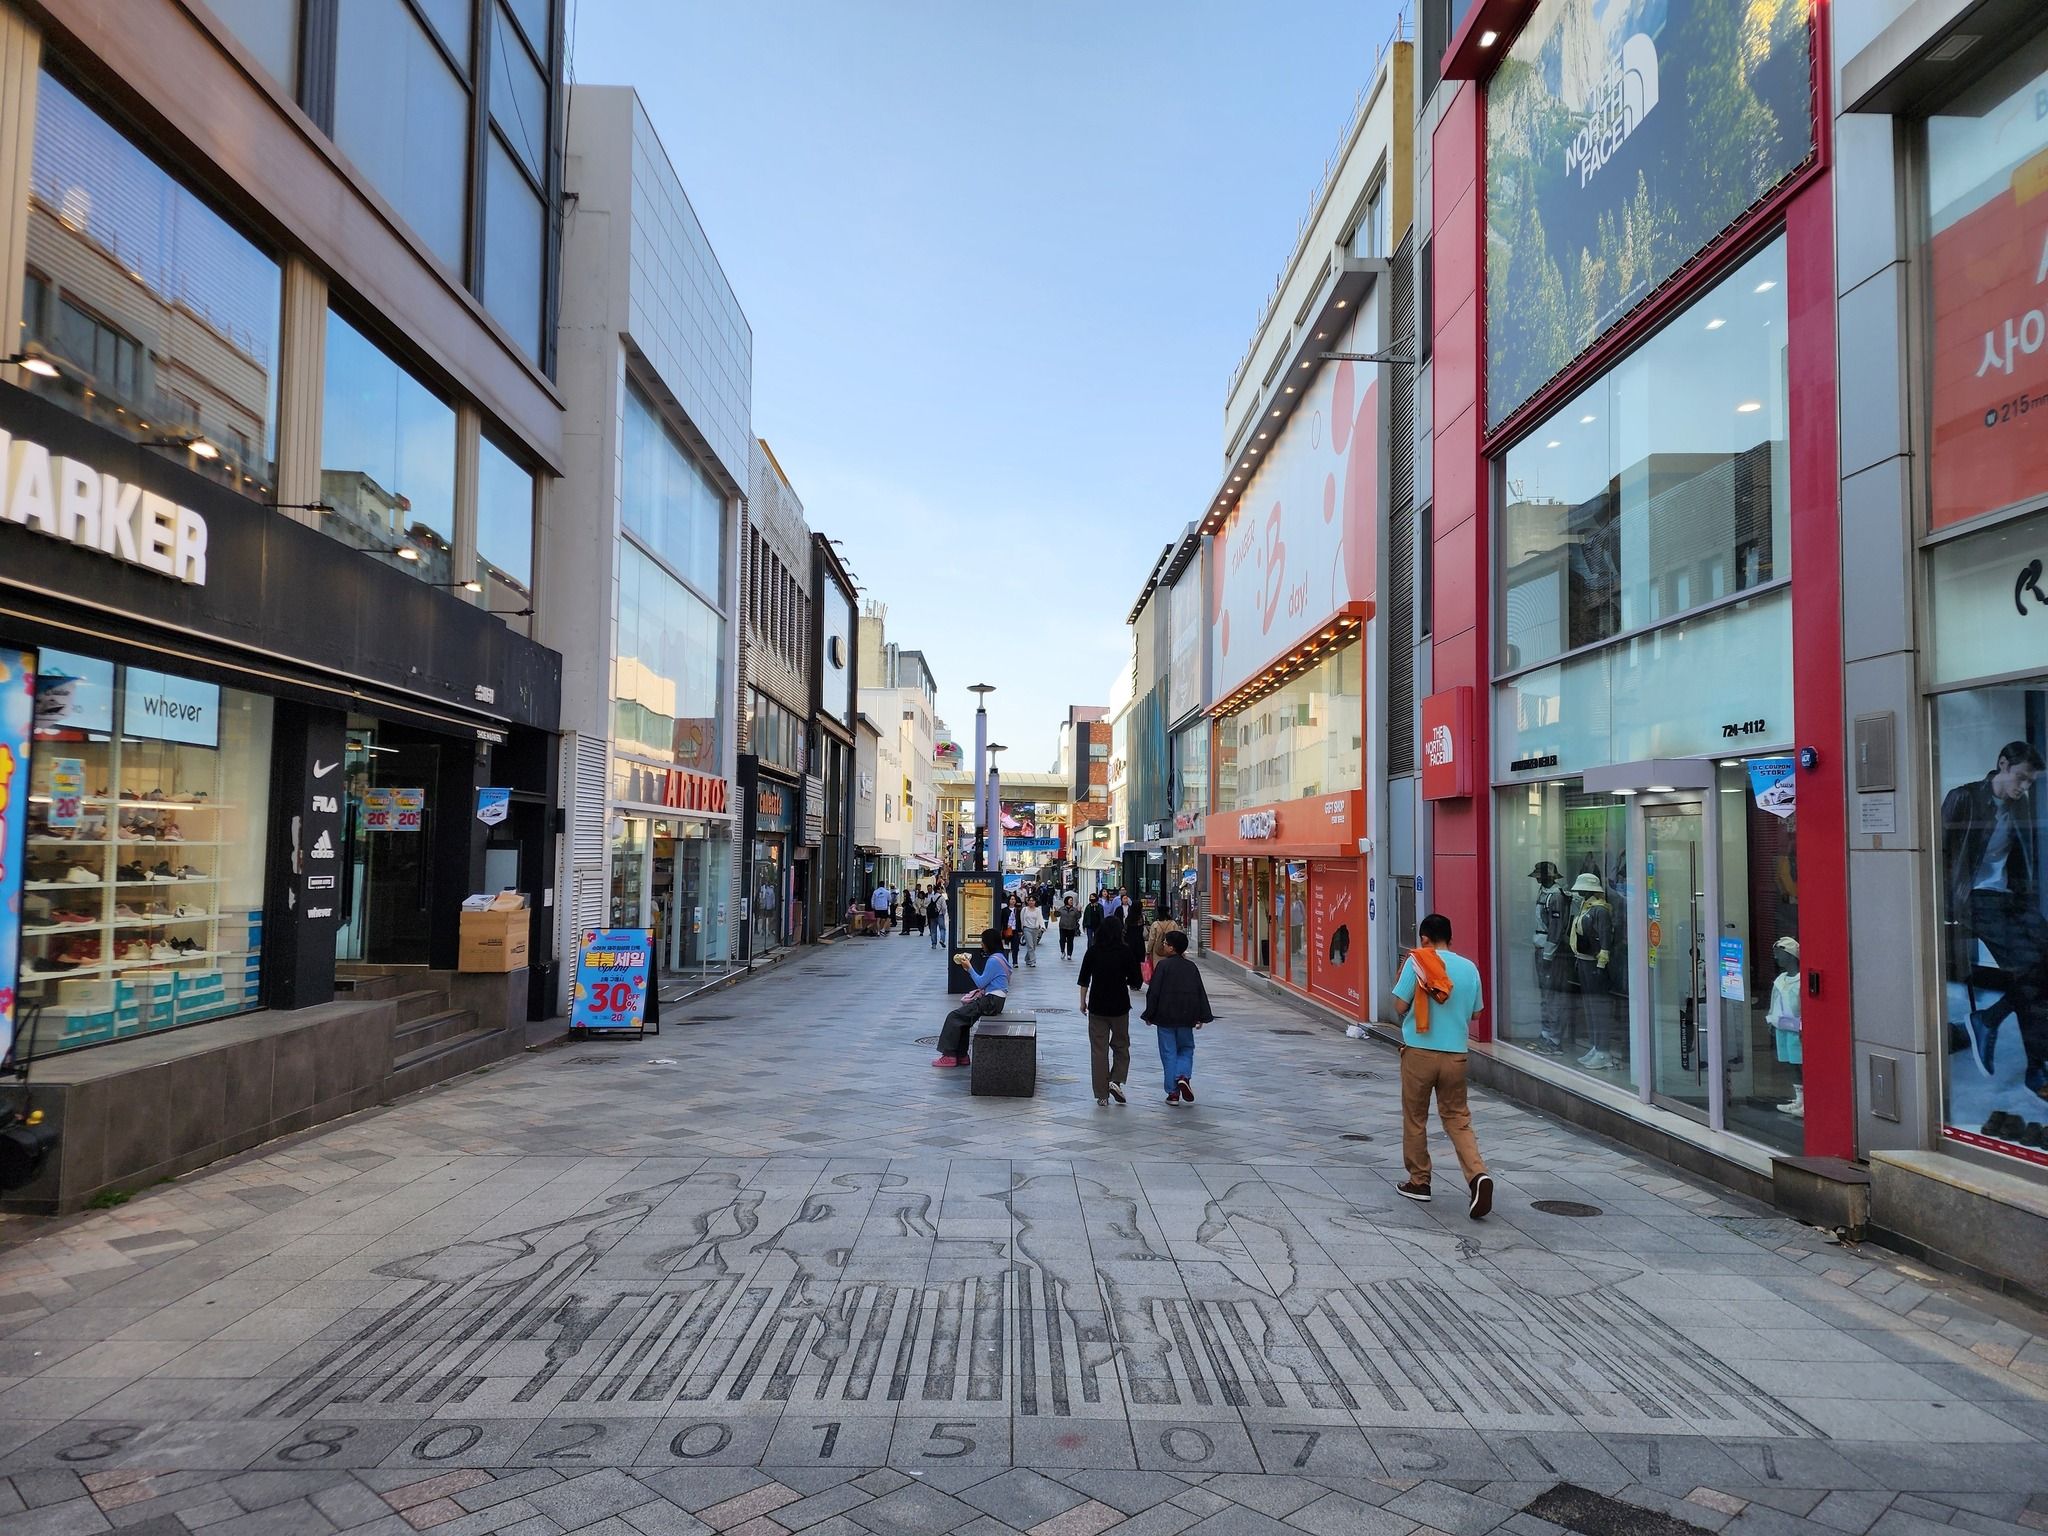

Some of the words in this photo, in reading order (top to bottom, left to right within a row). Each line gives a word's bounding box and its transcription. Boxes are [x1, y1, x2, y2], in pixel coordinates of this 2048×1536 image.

[1566, 80, 1624, 177] NORTH
[1582, 114, 1624, 189] FACE
[143, 694, 202, 723] whever
[1432, 726, 1444, 739] THE
[1722, 719, 1766, 738] 724-4112
[1425, 739, 1444, 755] NORTH
[1430, 752, 1444, 766] FACE
[664, 768, 728, 814] ARTBOX
[312, 795, 338, 813] FILA
[1029, 839, 1056, 847] STORE
